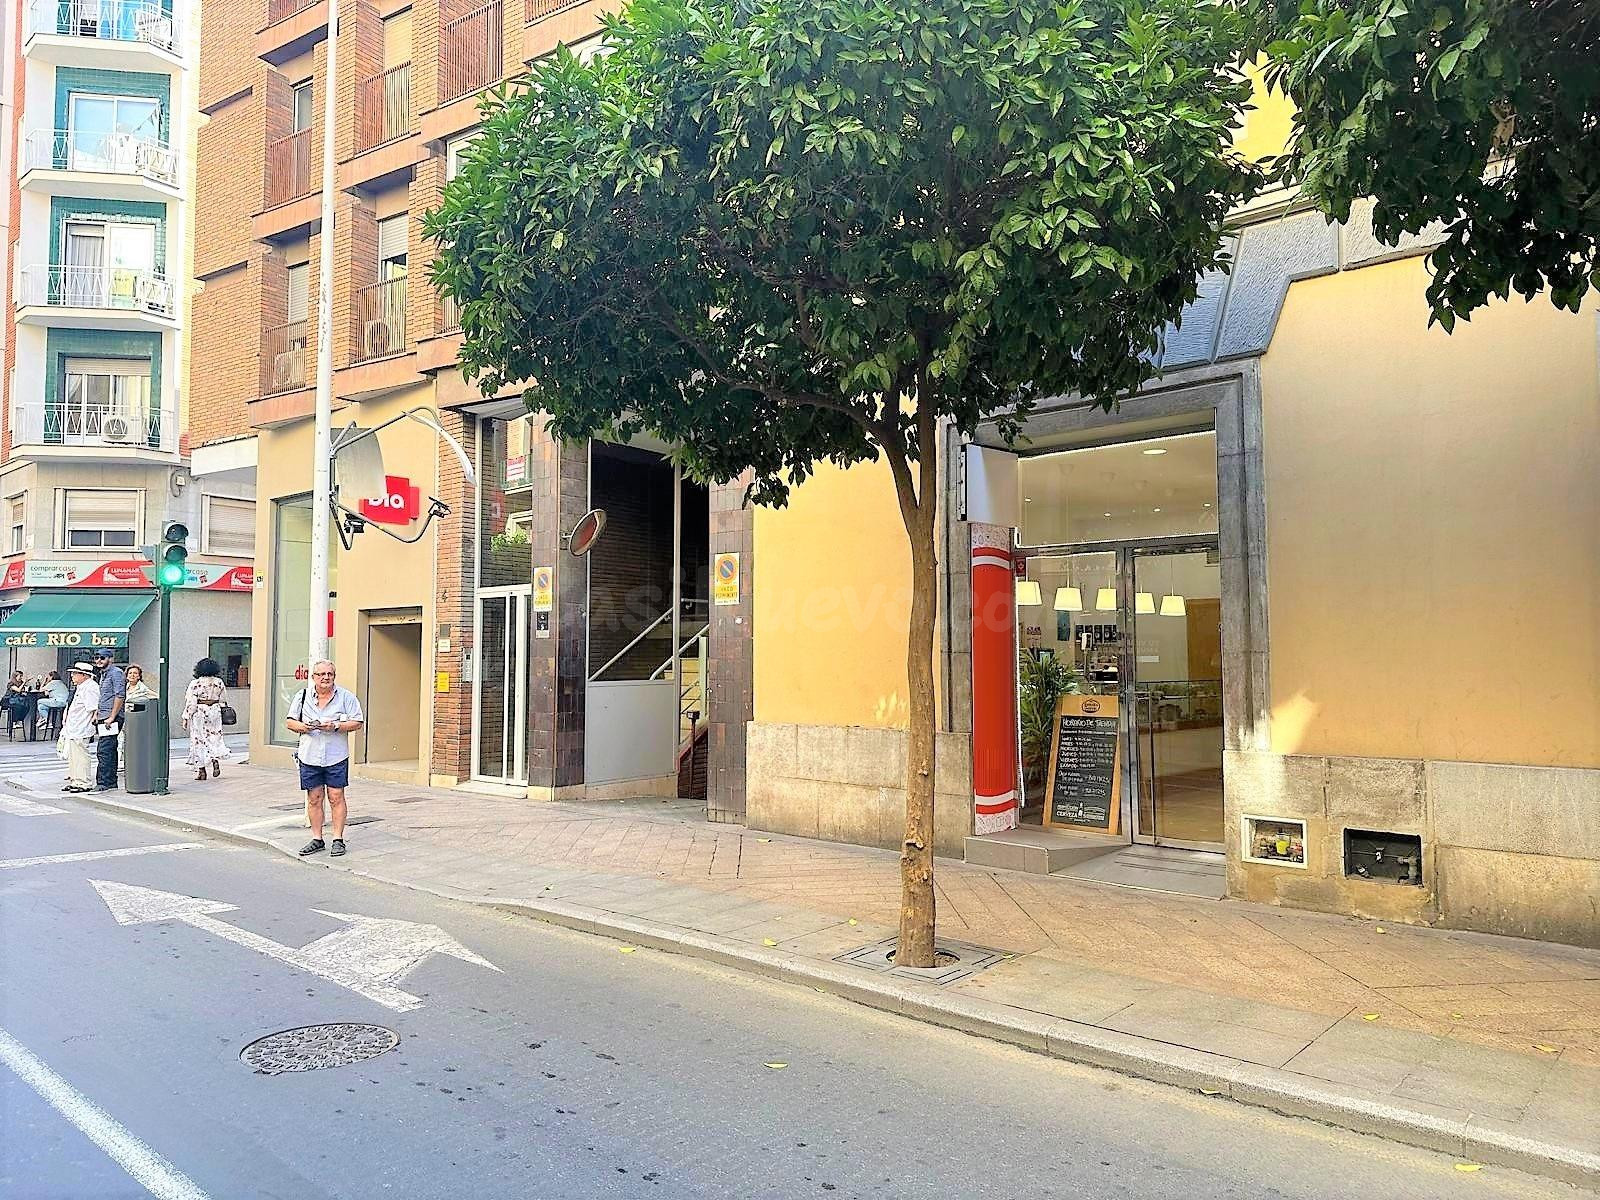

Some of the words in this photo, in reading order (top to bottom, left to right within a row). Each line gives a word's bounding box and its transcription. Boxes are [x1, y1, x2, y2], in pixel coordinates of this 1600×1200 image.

[5, 632, 38, 646] café
[47, 633, 82, 646] RIO
[91, 633, 118, 646] bar
